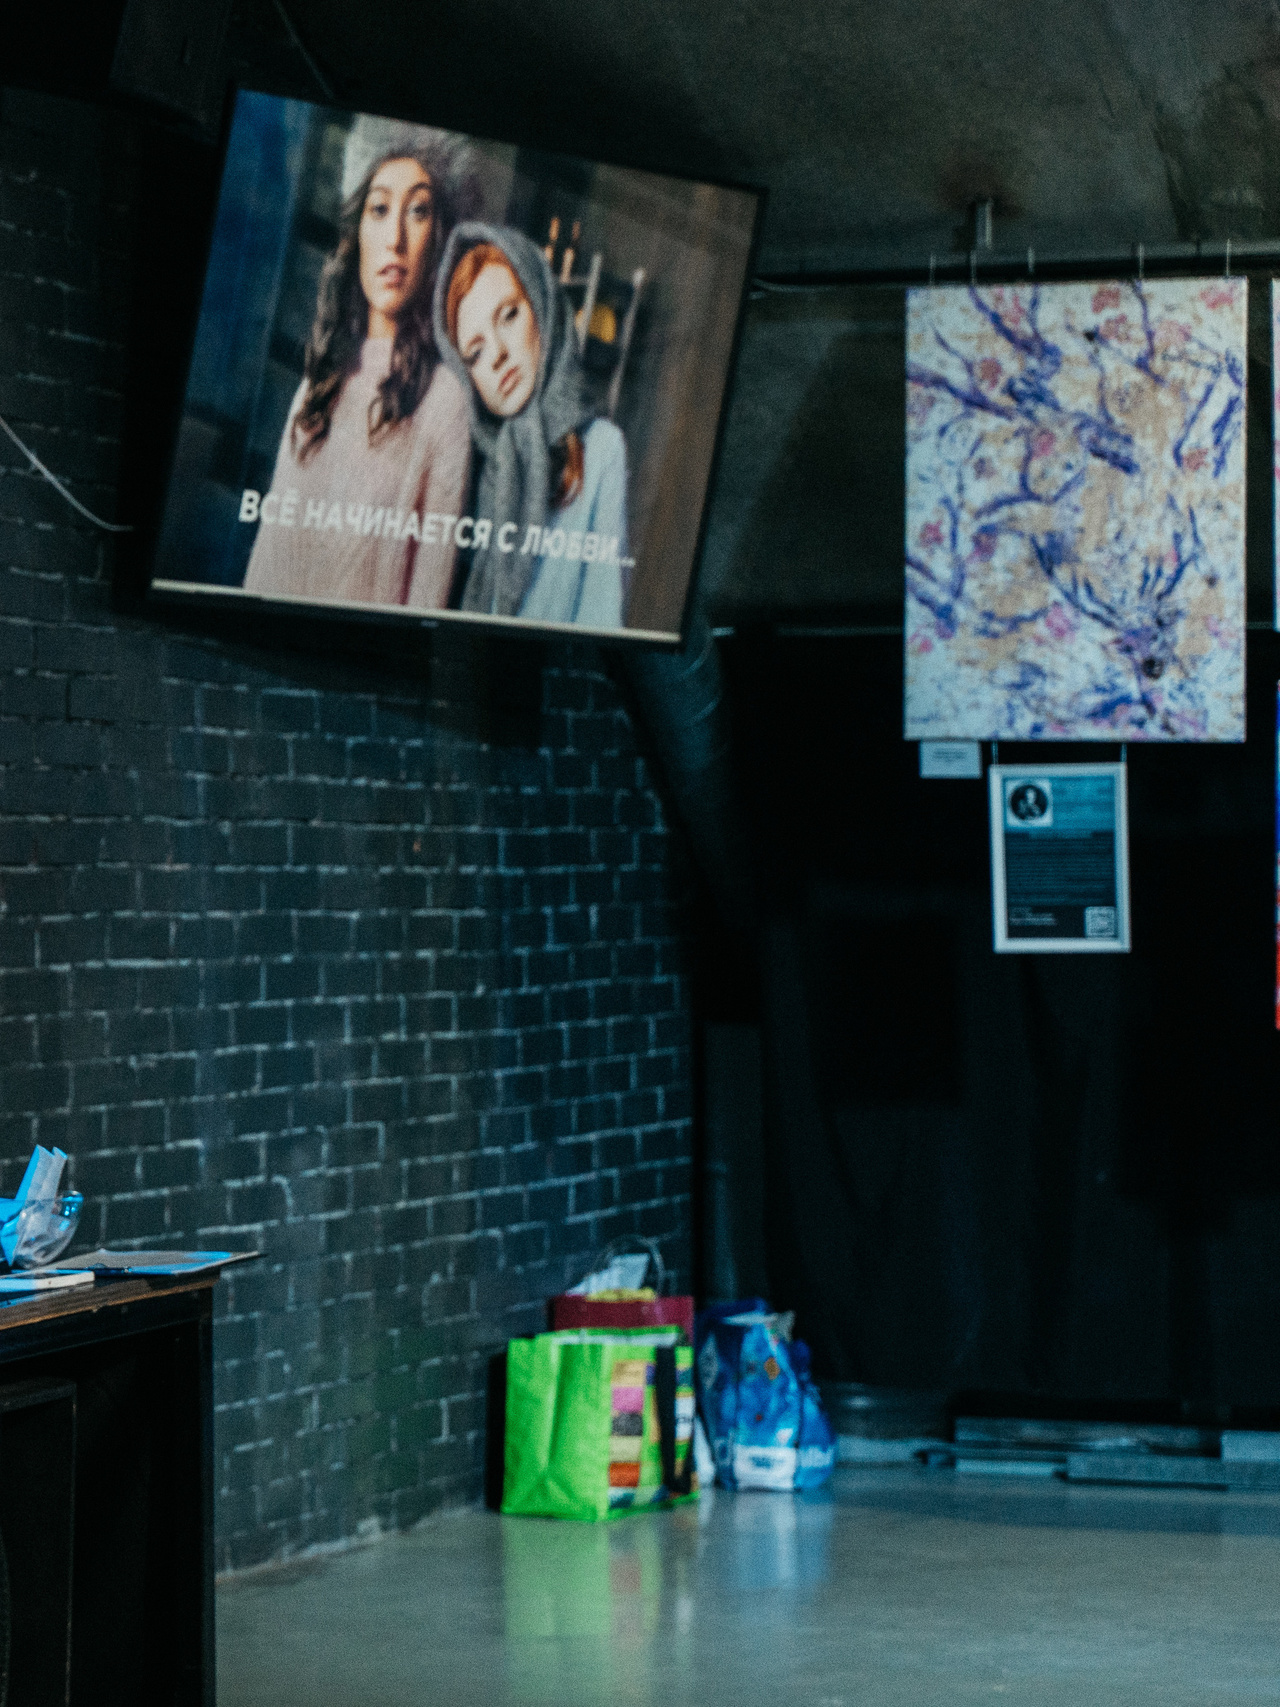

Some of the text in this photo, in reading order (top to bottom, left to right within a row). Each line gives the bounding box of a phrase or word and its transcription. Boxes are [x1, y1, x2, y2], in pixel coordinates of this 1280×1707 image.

[238, 487, 298, 528] ВСЁ
[302, 498, 493, 550] НАЧИНАЕТСЯ
[497, 521, 518, 553] С
